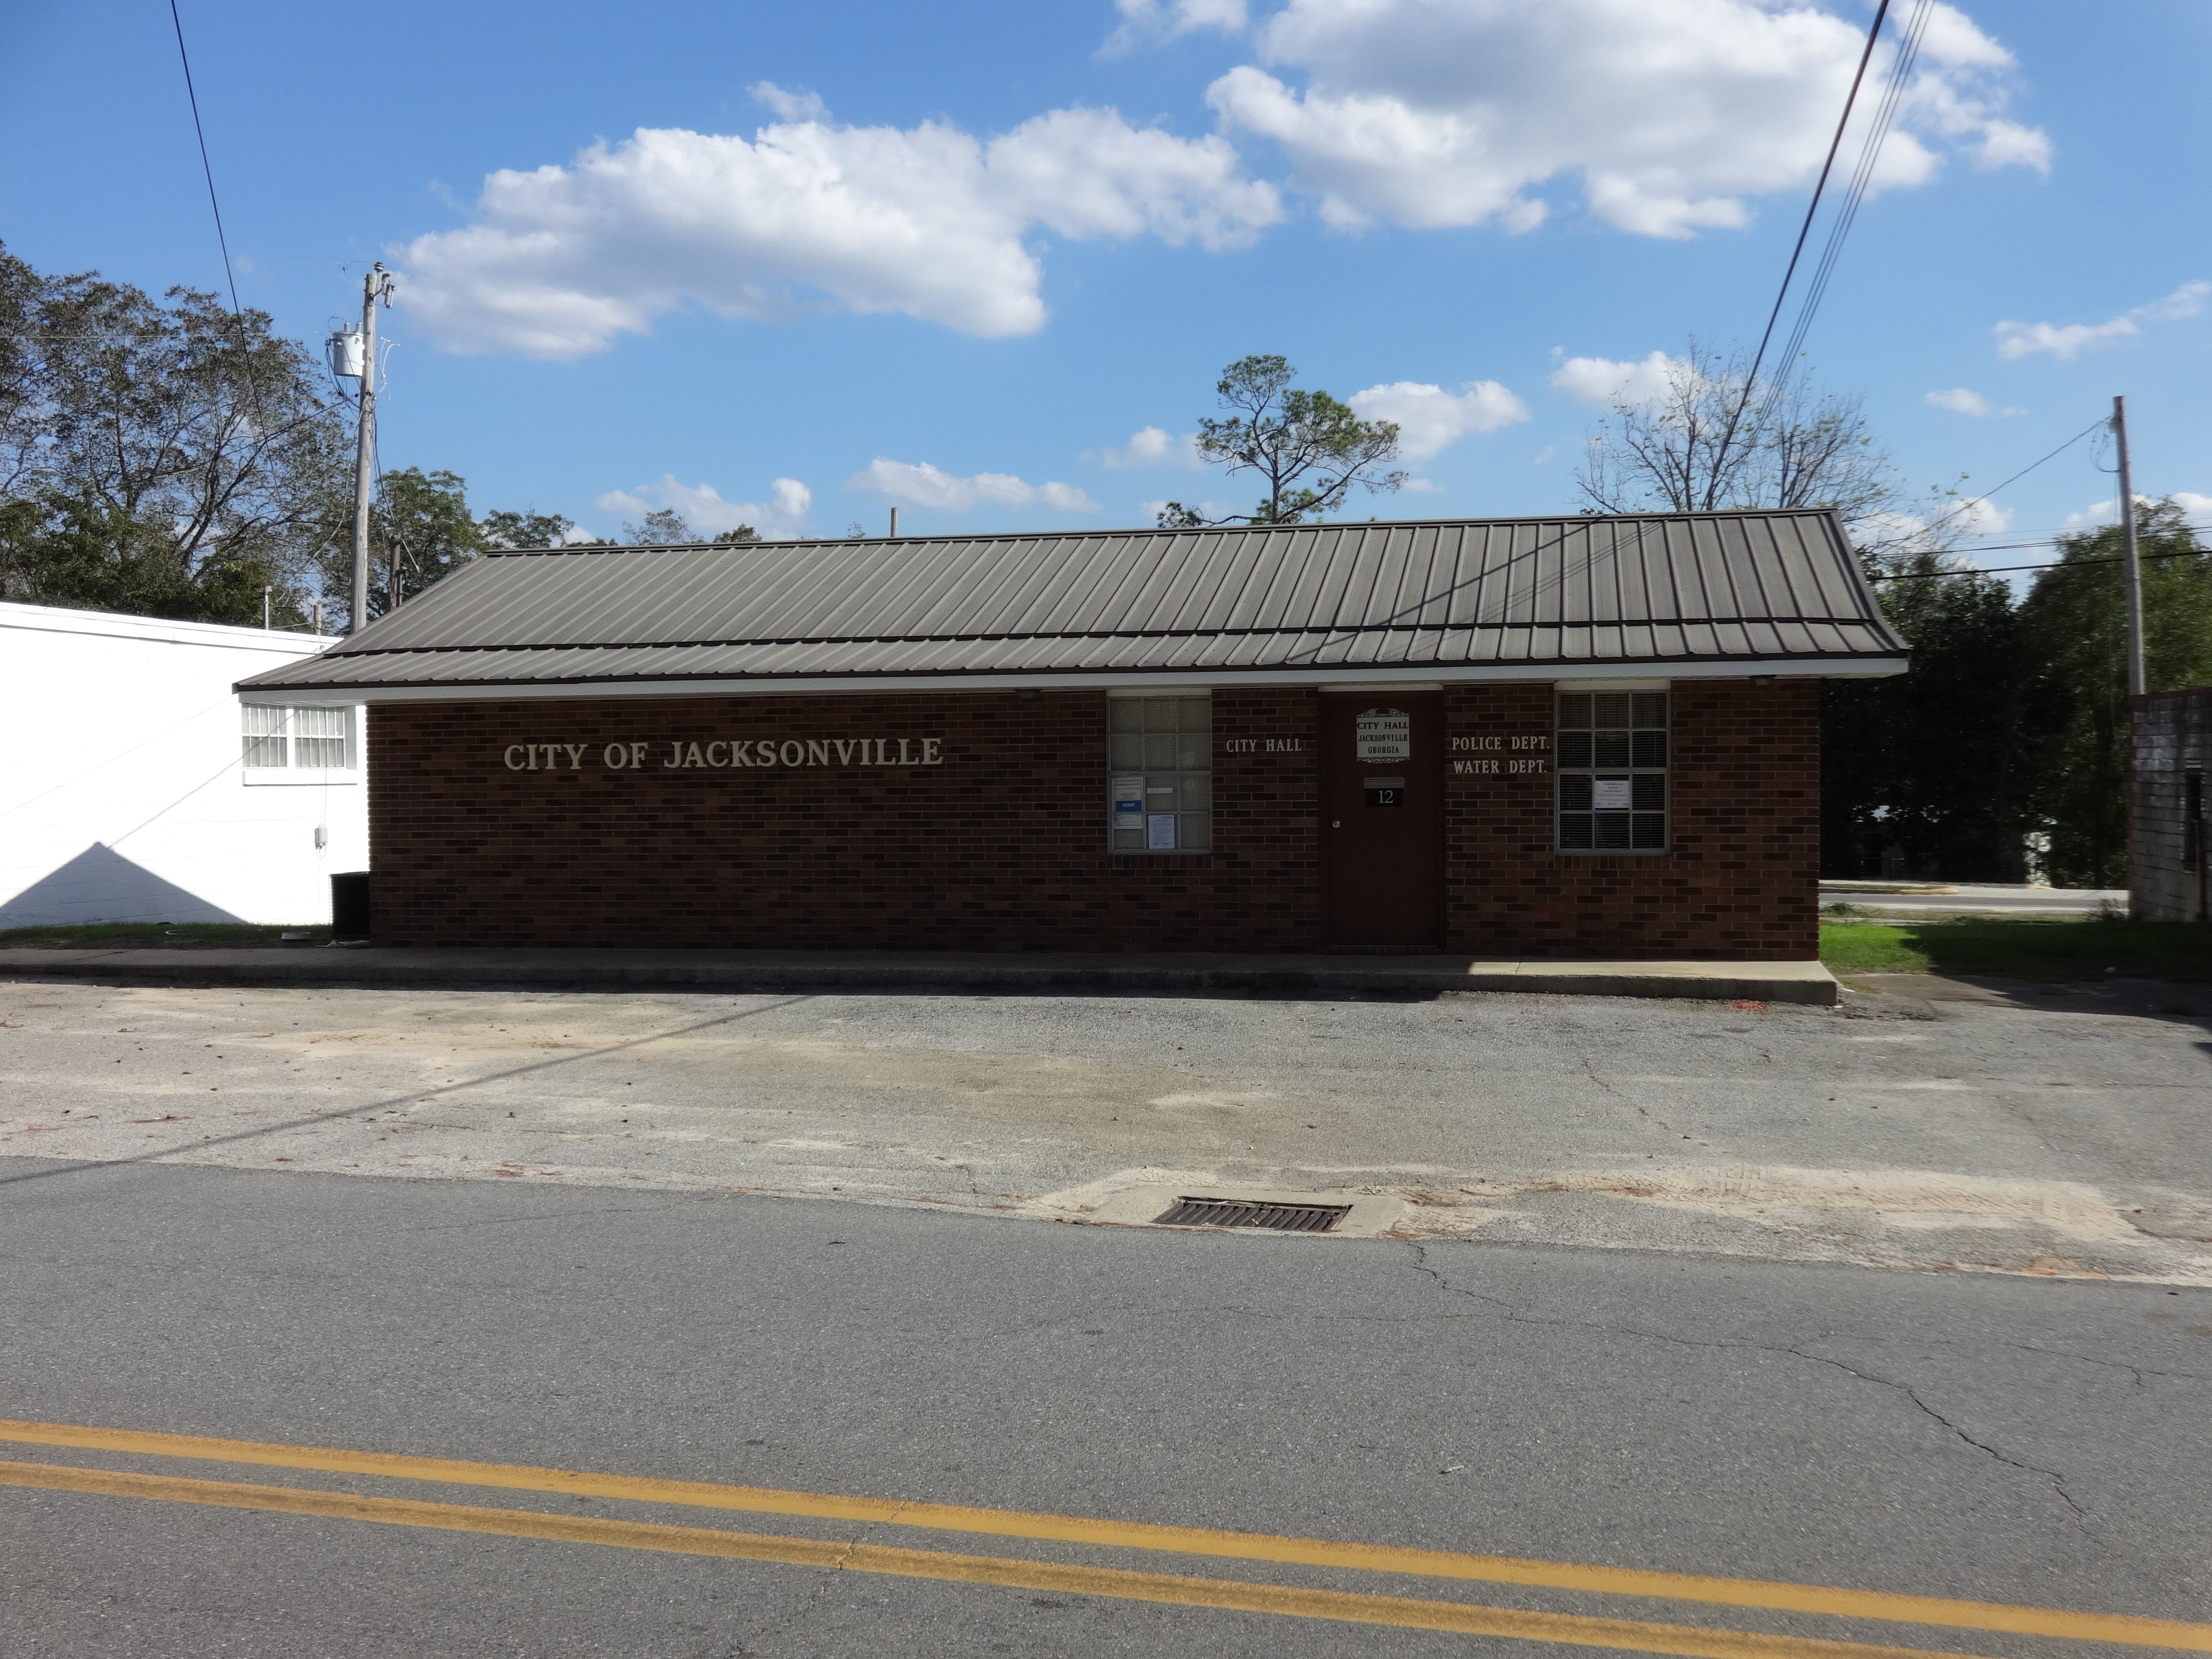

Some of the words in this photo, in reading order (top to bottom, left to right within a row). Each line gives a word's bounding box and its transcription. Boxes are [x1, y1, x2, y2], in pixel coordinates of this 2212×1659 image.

[1358, 734, 1408, 742] JACKSONVILLE
[1452, 736, 1502, 750] POLICE
[1511, 736, 1550, 750] DEPT.
[1226, 739, 1257, 753] CITY
[1265, 738, 1301, 752] HALL
[504, 744, 589, 770] CITY
[603, 743, 648, 769] OF
[664, 737, 943, 768] JACKSONVILLE
[1453, 760, 1500, 774] WATER
[1509, 759, 1547, 773] DEPT.
[1378, 790, 1394, 804] 12
